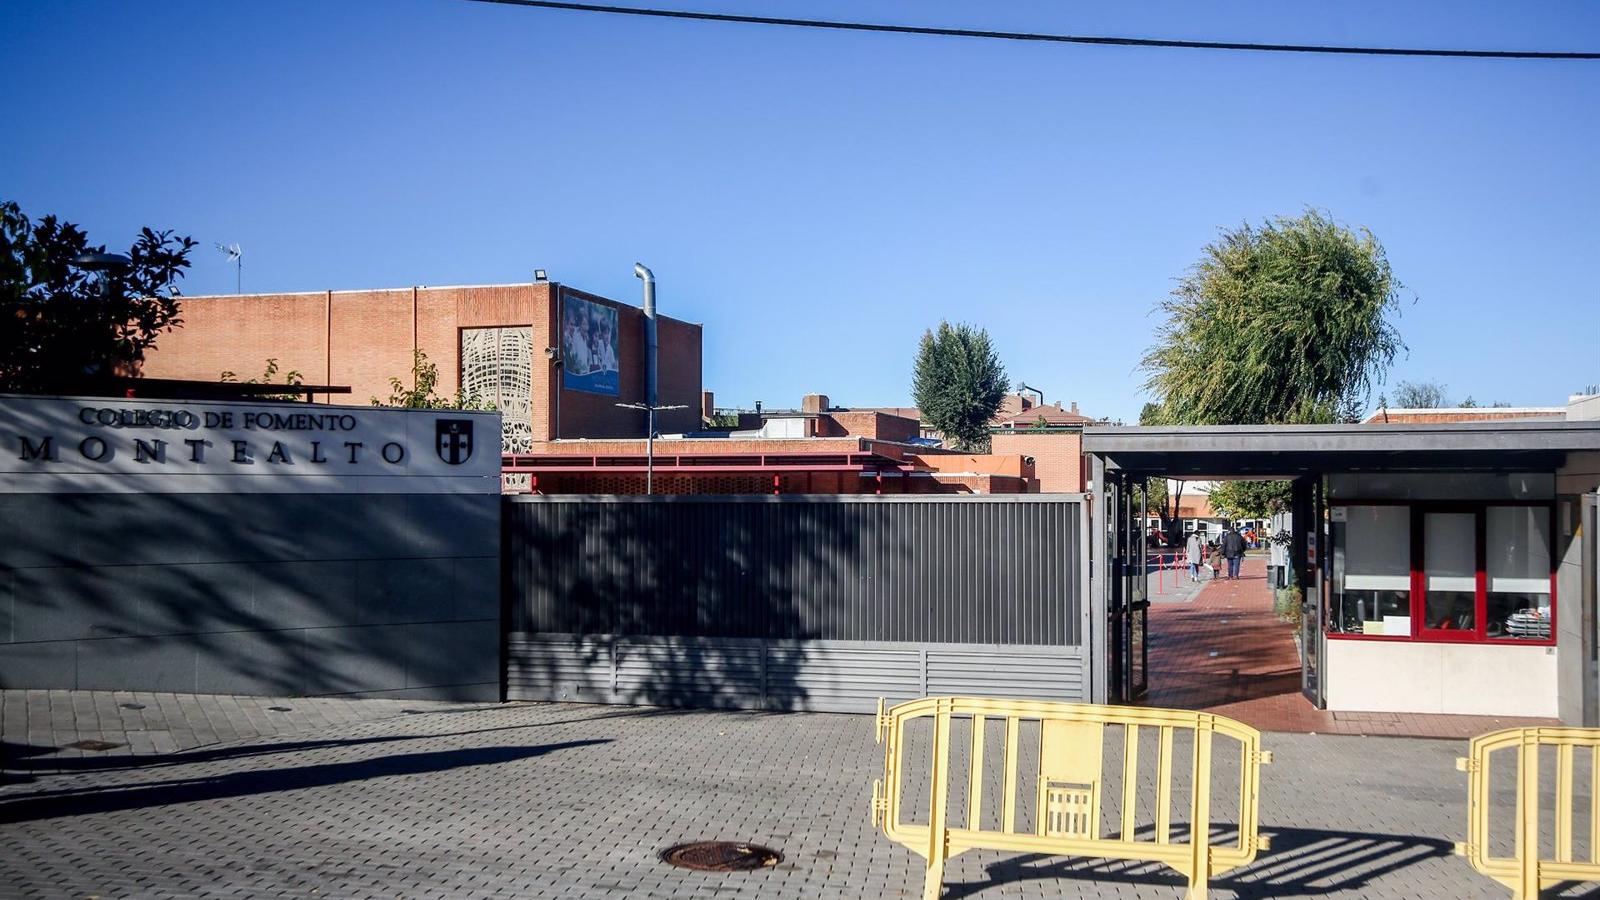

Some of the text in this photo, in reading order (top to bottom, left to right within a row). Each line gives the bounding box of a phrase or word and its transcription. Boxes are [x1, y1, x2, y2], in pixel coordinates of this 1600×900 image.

[79, 407, 356, 431] COLEGIO DE FOMENTO
[18, 436, 404, 464] MONTEALTO
